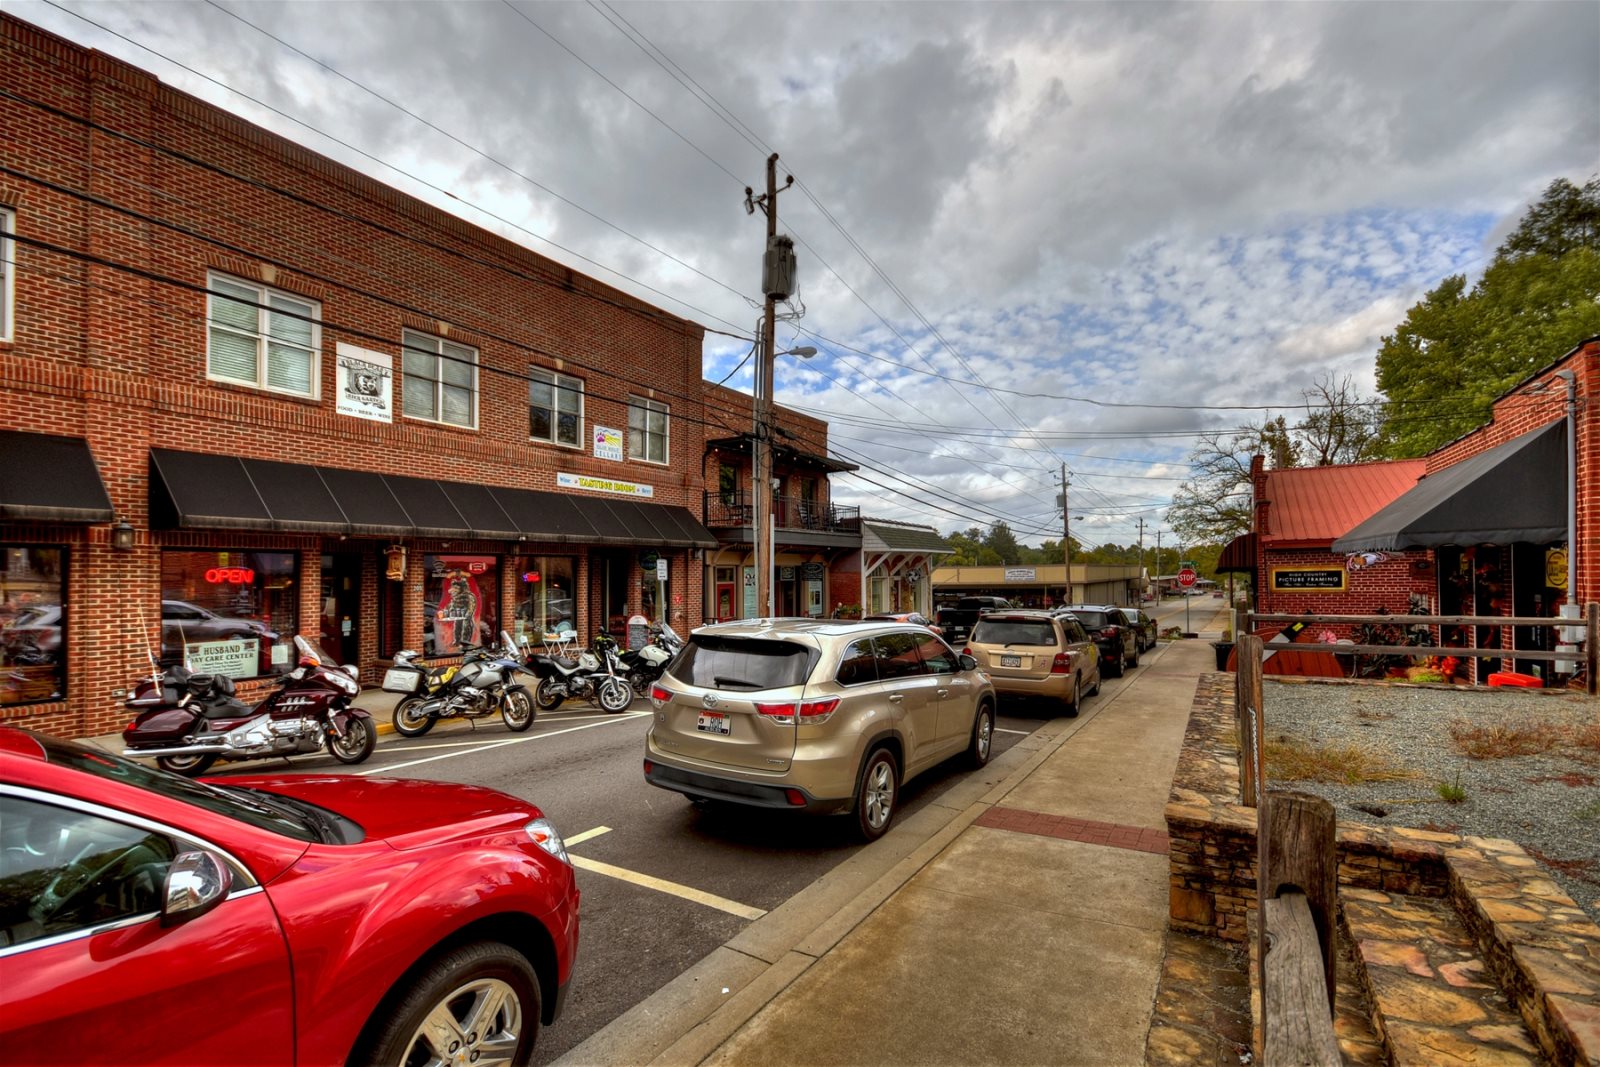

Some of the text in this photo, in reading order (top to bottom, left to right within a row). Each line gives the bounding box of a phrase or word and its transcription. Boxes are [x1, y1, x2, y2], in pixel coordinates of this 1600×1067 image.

[578, 478, 612, 491] TASTING
[613, 483, 636, 493] ROOM
[205, 569, 254, 583] OPEN
[204, 645, 240, 655] HUSBAND
